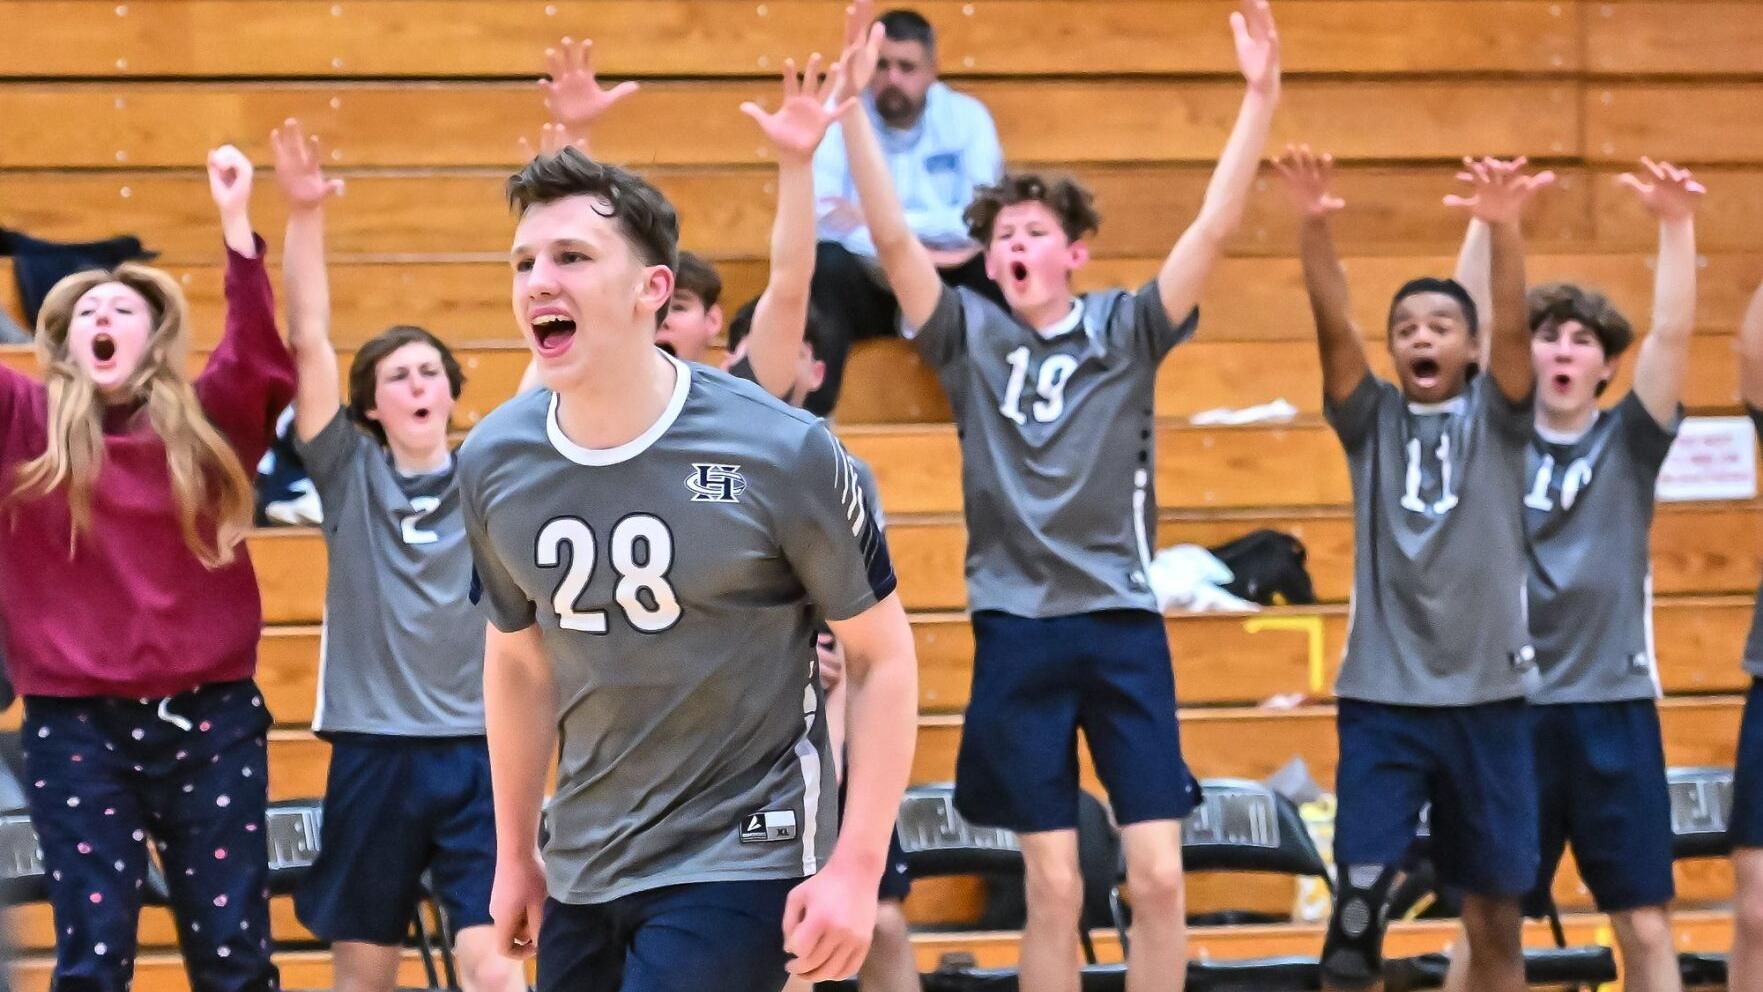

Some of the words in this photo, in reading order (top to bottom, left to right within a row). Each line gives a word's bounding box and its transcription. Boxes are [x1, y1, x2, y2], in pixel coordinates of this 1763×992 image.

[999, 345, 1079, 425] 19
[1400, 431, 1459, 514] 11
[400, 495, 441, 544] 2
[534, 511, 684, 636] 28
